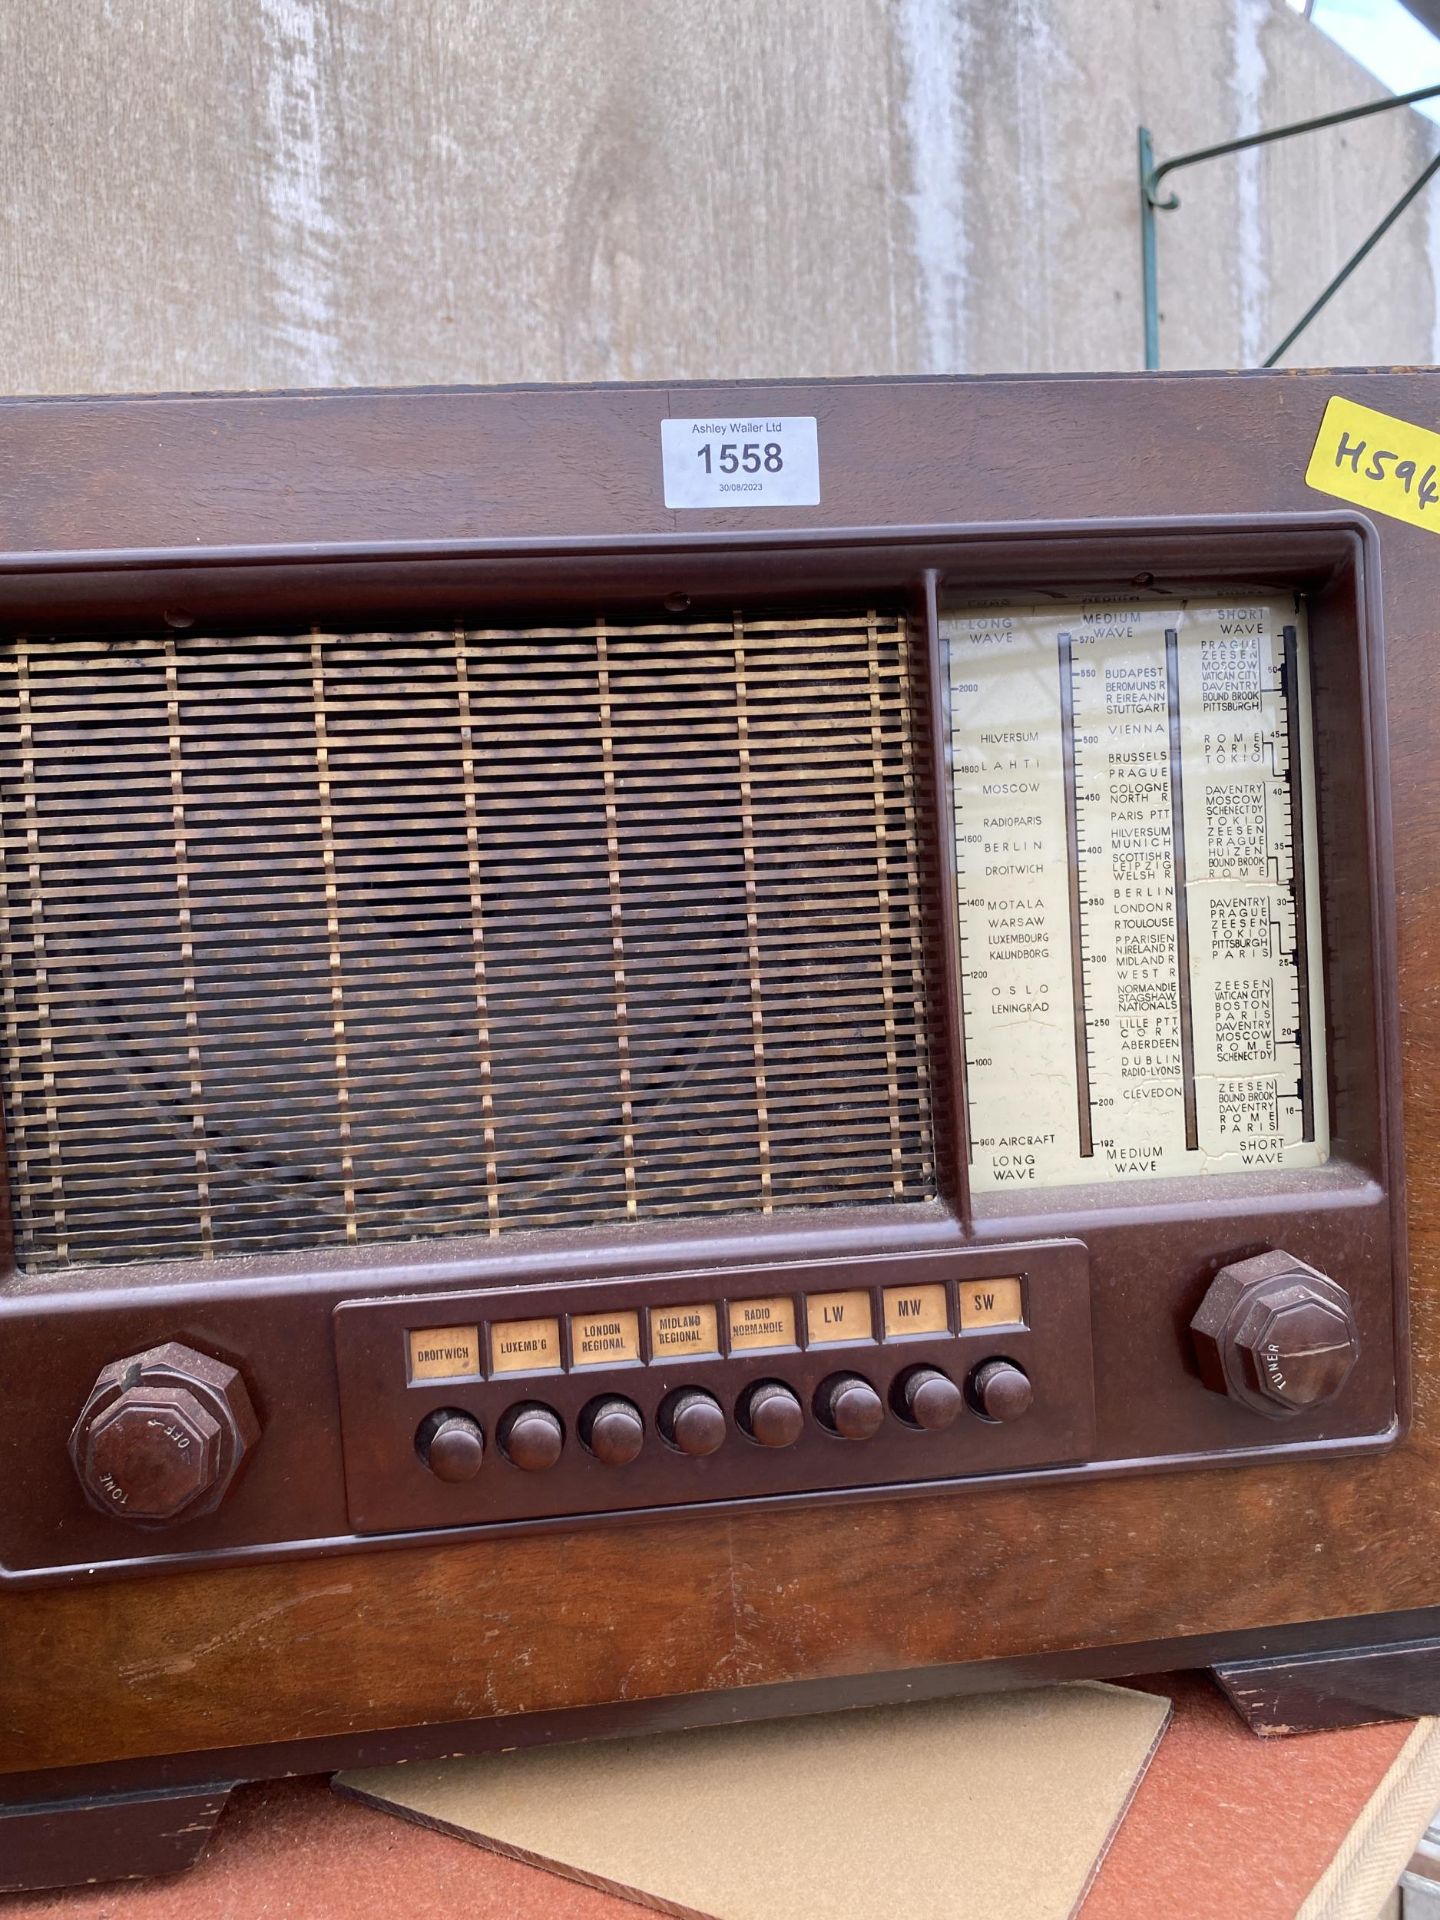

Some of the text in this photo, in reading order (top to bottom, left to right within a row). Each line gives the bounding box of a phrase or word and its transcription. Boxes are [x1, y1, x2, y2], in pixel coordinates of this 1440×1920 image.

[692, 422, 782, 435] Ashley Waller Ltd
[697, 443, 783, 473] 1558
[719, 483, 762, 492] 30/08/2023
[1083, 613, 1141, 624] MEDIUM
[1218, 609, 1264, 620] SHORT
[968, 618, 1012, 630] LONG
[1220, 623, 1263, 634] WAVE
[970, 632, 1013, 643] WAVE
[1094, 627, 1133, 638] WAVE
[1080, 636, 1095, 644] 570
[1201, 640, 1257, 650] PRAGUE
[1202, 650, 1257, 660] ZEESEN
[1202, 661, 1257, 671] MOSCOW
[1105, 667, 1163, 679] BUDAPEST
[1202, 671, 1258, 681] VATICAN CITY
[959, 684, 978, 692] 2000
[1203, 681, 1258, 691] DAVENTRY
[1107, 693, 1165, 704] R EIREANN
[1203, 691, 1259, 701] BOUND BROOK
[1107, 703, 1166, 715] STUTTGART
[1204, 702, 1259, 712] PITTSBURGH
[1108, 724, 1165, 735] VIENNA
[980, 732, 1039, 743] HILVERSUM
[1083, 736, 1098, 744] 500
[1205, 732, 1260, 743] ROME
[1205, 743, 1260, 753] PARIS
[1109, 751, 1167, 763] BRUSSELS
[1206, 753, 1260, 764] TOKIO
[961, 765, 979, 773] 1800
[982, 760, 1040, 771] LAHTI
[1110, 767, 1167, 778] PRAGUE
[982, 783, 1040, 794] MOSCOW
[1110, 782, 1168, 794] COLOGNE
[1206, 784, 1262, 795] DAVENTRY
[1085, 793, 1100, 801] 450
[1111, 793, 1168, 804] NORTH R
[1206, 795, 1261, 805] MOSCOW
[1111, 810, 1170, 821] PARIS PTT
[1208, 815, 1264, 826] TOKIO
[984, 816, 1042, 827] RADIOPARIS
[1111, 826, 1171, 838] HILVERSUM
[1208, 825, 1264, 836] ZEESEN
[964, 835, 982, 843] 1600
[1111, 838, 1171, 848] MUNICH
[1209, 836, 1264, 847] PRAGUE
[985, 841, 1041, 852] BERLIN
[1209, 846, 1262, 857] HUIZEN
[1113, 851, 1171, 862] SCOTTISH R
[1113, 861, 1171, 872] LEIPZIG
[1209, 857, 1264, 868] BOUND BROOK
[985, 864, 1044, 876] DROITWICH
[1114, 870, 1171, 881] WELSH R
[1209, 867, 1264, 878] ROME
[1114, 887, 1173, 898] BERLIN
[988, 899, 1044, 910] MOTALA
[1089, 898, 1104, 906] 350
[1210, 898, 1266, 908] DAVENTRY
[1114, 903, 1172, 914] LONDON R
[1211, 907, 1267, 918] PRAGUE
[988, 916, 1044, 928] WARSAW
[1115, 918, 1174, 929] R TOULOUSE
[1212, 918, 1267, 929] ZEESEN
[989, 933, 1049, 944] LUXEMBOURG
[1116, 934, 1175, 944] P PARISIEN
[1213, 928, 1267, 939] TOKIO
[1116, 943, 1174, 954] N IRELAND R
[1212, 938, 1268, 949] PITTSBURGH
[990, 949, 1049, 960] KALUNDBORG
[1213, 948, 1269, 959] PARIS
[1116, 955, 1174, 966] MIDLAND R
[1117, 968, 1175, 979] WEST R
[992, 984, 1048, 996] OSLO
[1118, 982, 1176, 994] NORMANDIE
[1215, 979, 1270, 991] ZEESEN
[1119, 992, 1176, 1003] STAGSHAW
[1215, 990, 1270, 1001] VATICAN CITY
[992, 1002, 1049, 1014] LENINGRAD
[1119, 1001, 1177, 1012] NATIONALS
[1215, 1000, 1269, 1011] BOSTON
[1216, 1010, 1270, 1021] PARIS
[1120, 1017, 1178, 1028] LILLE PTT
[1216, 1020, 1271, 1032] DAVENTRY
[1121, 1027, 1178, 1038] CORK
[1216, 1030, 1271, 1042] MOSCOW
[1121, 1039, 1179, 1050] ABERDEEN
[1217, 1040, 1271, 1053] ROME
[975, 1058, 992, 1066] 1000
[1122, 1054, 1180, 1066] DUBLIN
[1122, 1066, 1181, 1078] RADIO-LYONS
[1219, 1081, 1274, 1093] ZEESEN
[1123, 1087, 1181, 1099] CLEVEDON
[1219, 1092, 1274, 1103] BOUND BROOK
[1220, 1102, 1274, 1113] DAVENTRY
[1286, 1107, 1294, 1115] 16
[1220, 1111, 1275, 1123] ROME
[1220, 1122, 1275, 1134] PARIS
[980, 1135, 1055, 1146] 900 AIRCRAFT
[1240, 1138, 1284, 1151] SHORT
[1107, 1147, 1162, 1159] MEDIUM
[1242, 1153, 1284, 1164] WAVE
[993, 1154, 1035, 1167] LONG
[1115, 1161, 1157, 1173] WAVE
[993, 1168, 1035, 1180] WAVE
[898, 1299, 922, 1317] MW
[974, 1294, 995, 1312] SW
[744, 1308, 770, 1321] RADIO
[824, 1306, 844, 1324] LW
[660, 1315, 701, 1330] MIDLAND
[584, 1323, 621, 1337] LONDON
[732, 1321, 784, 1337] NORMANDIE
[659, 1331, 701, 1344] REGIONAL
[501, 1339, 547, 1354] LUXEMB'G
[582, 1337, 626, 1353] REGIONAL
[418, 1347, 469, 1362] DROITWICH
[1267, 1343, 1287, 1390] TUNER
[163, 1425, 190, 1448] OFF
[100, 1472, 129, 1504] TONE
